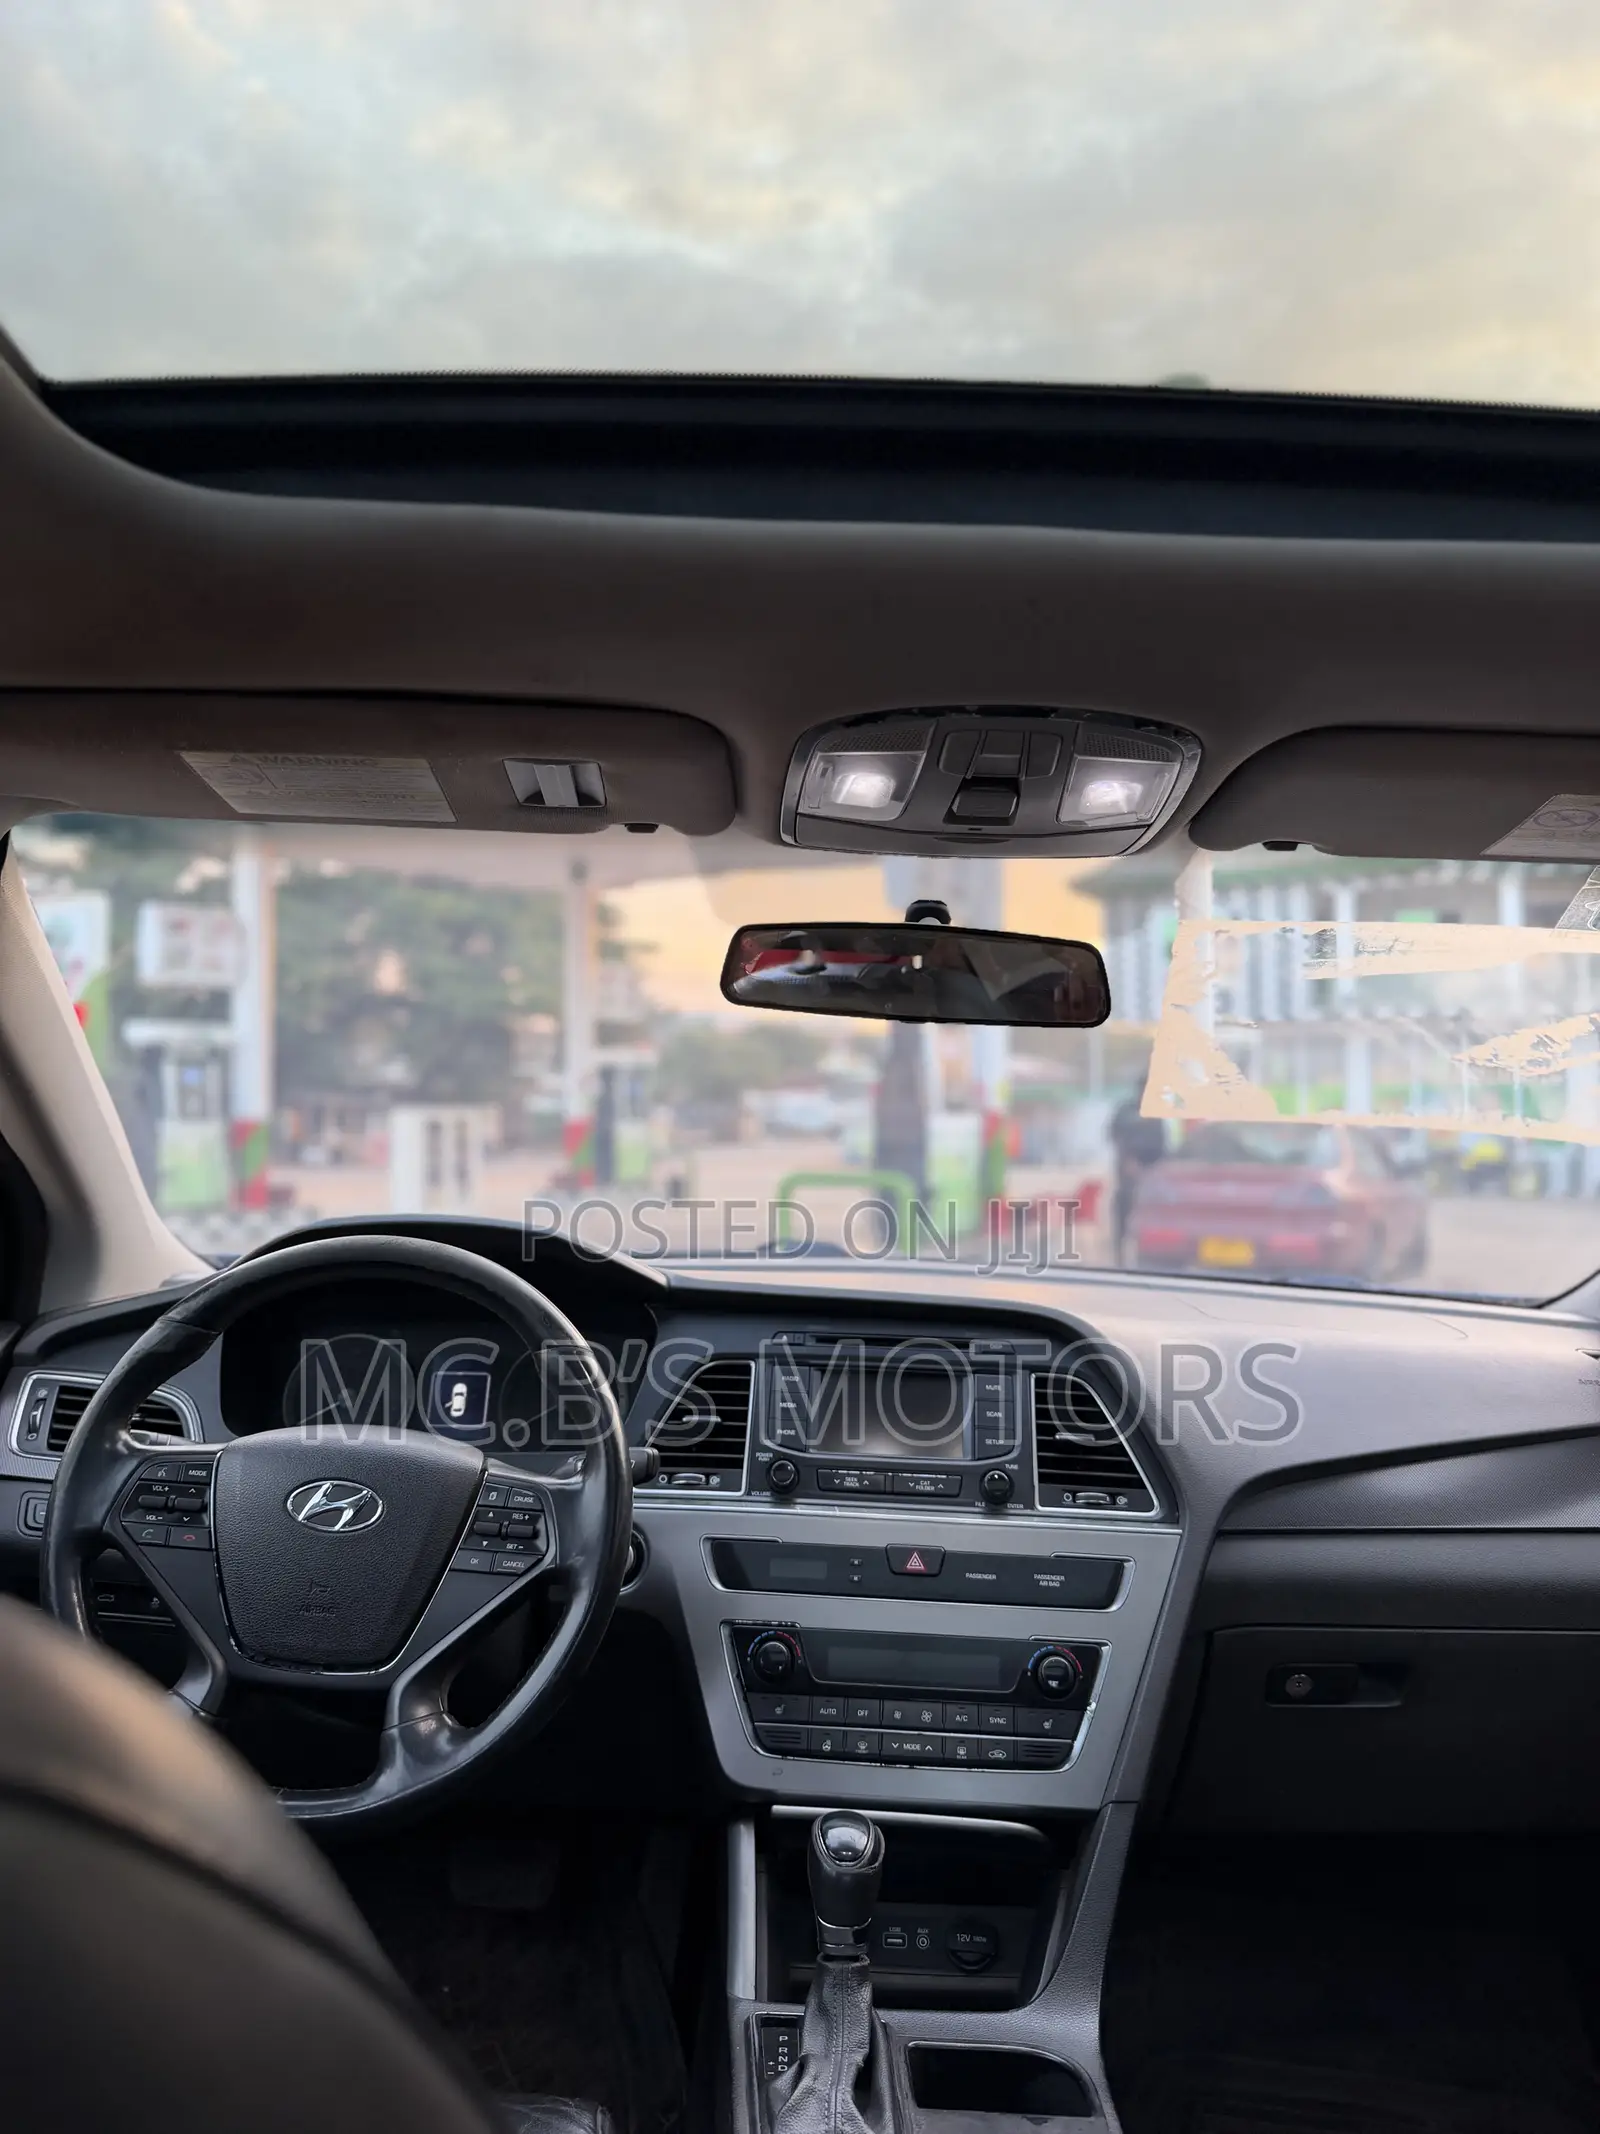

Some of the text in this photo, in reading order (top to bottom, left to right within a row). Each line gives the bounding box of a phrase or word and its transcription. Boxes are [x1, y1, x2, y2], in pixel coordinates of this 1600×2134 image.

[258, 754, 378, 767] WARNING
[985, 1438, 1004, 1446] SETUP
[502, 1560, 525, 1568] CANCEL
[965, 1572, 997, 1580] PASSENGER
[1033, 1573, 1065, 1582] PASSENGER
[955, 1714, 968, 1722] A/C
[989, 1717, 1007, 1725] SYNC
[903, 1743, 921, 1751] MODE
[956, 1933, 971, 1942] 12V
